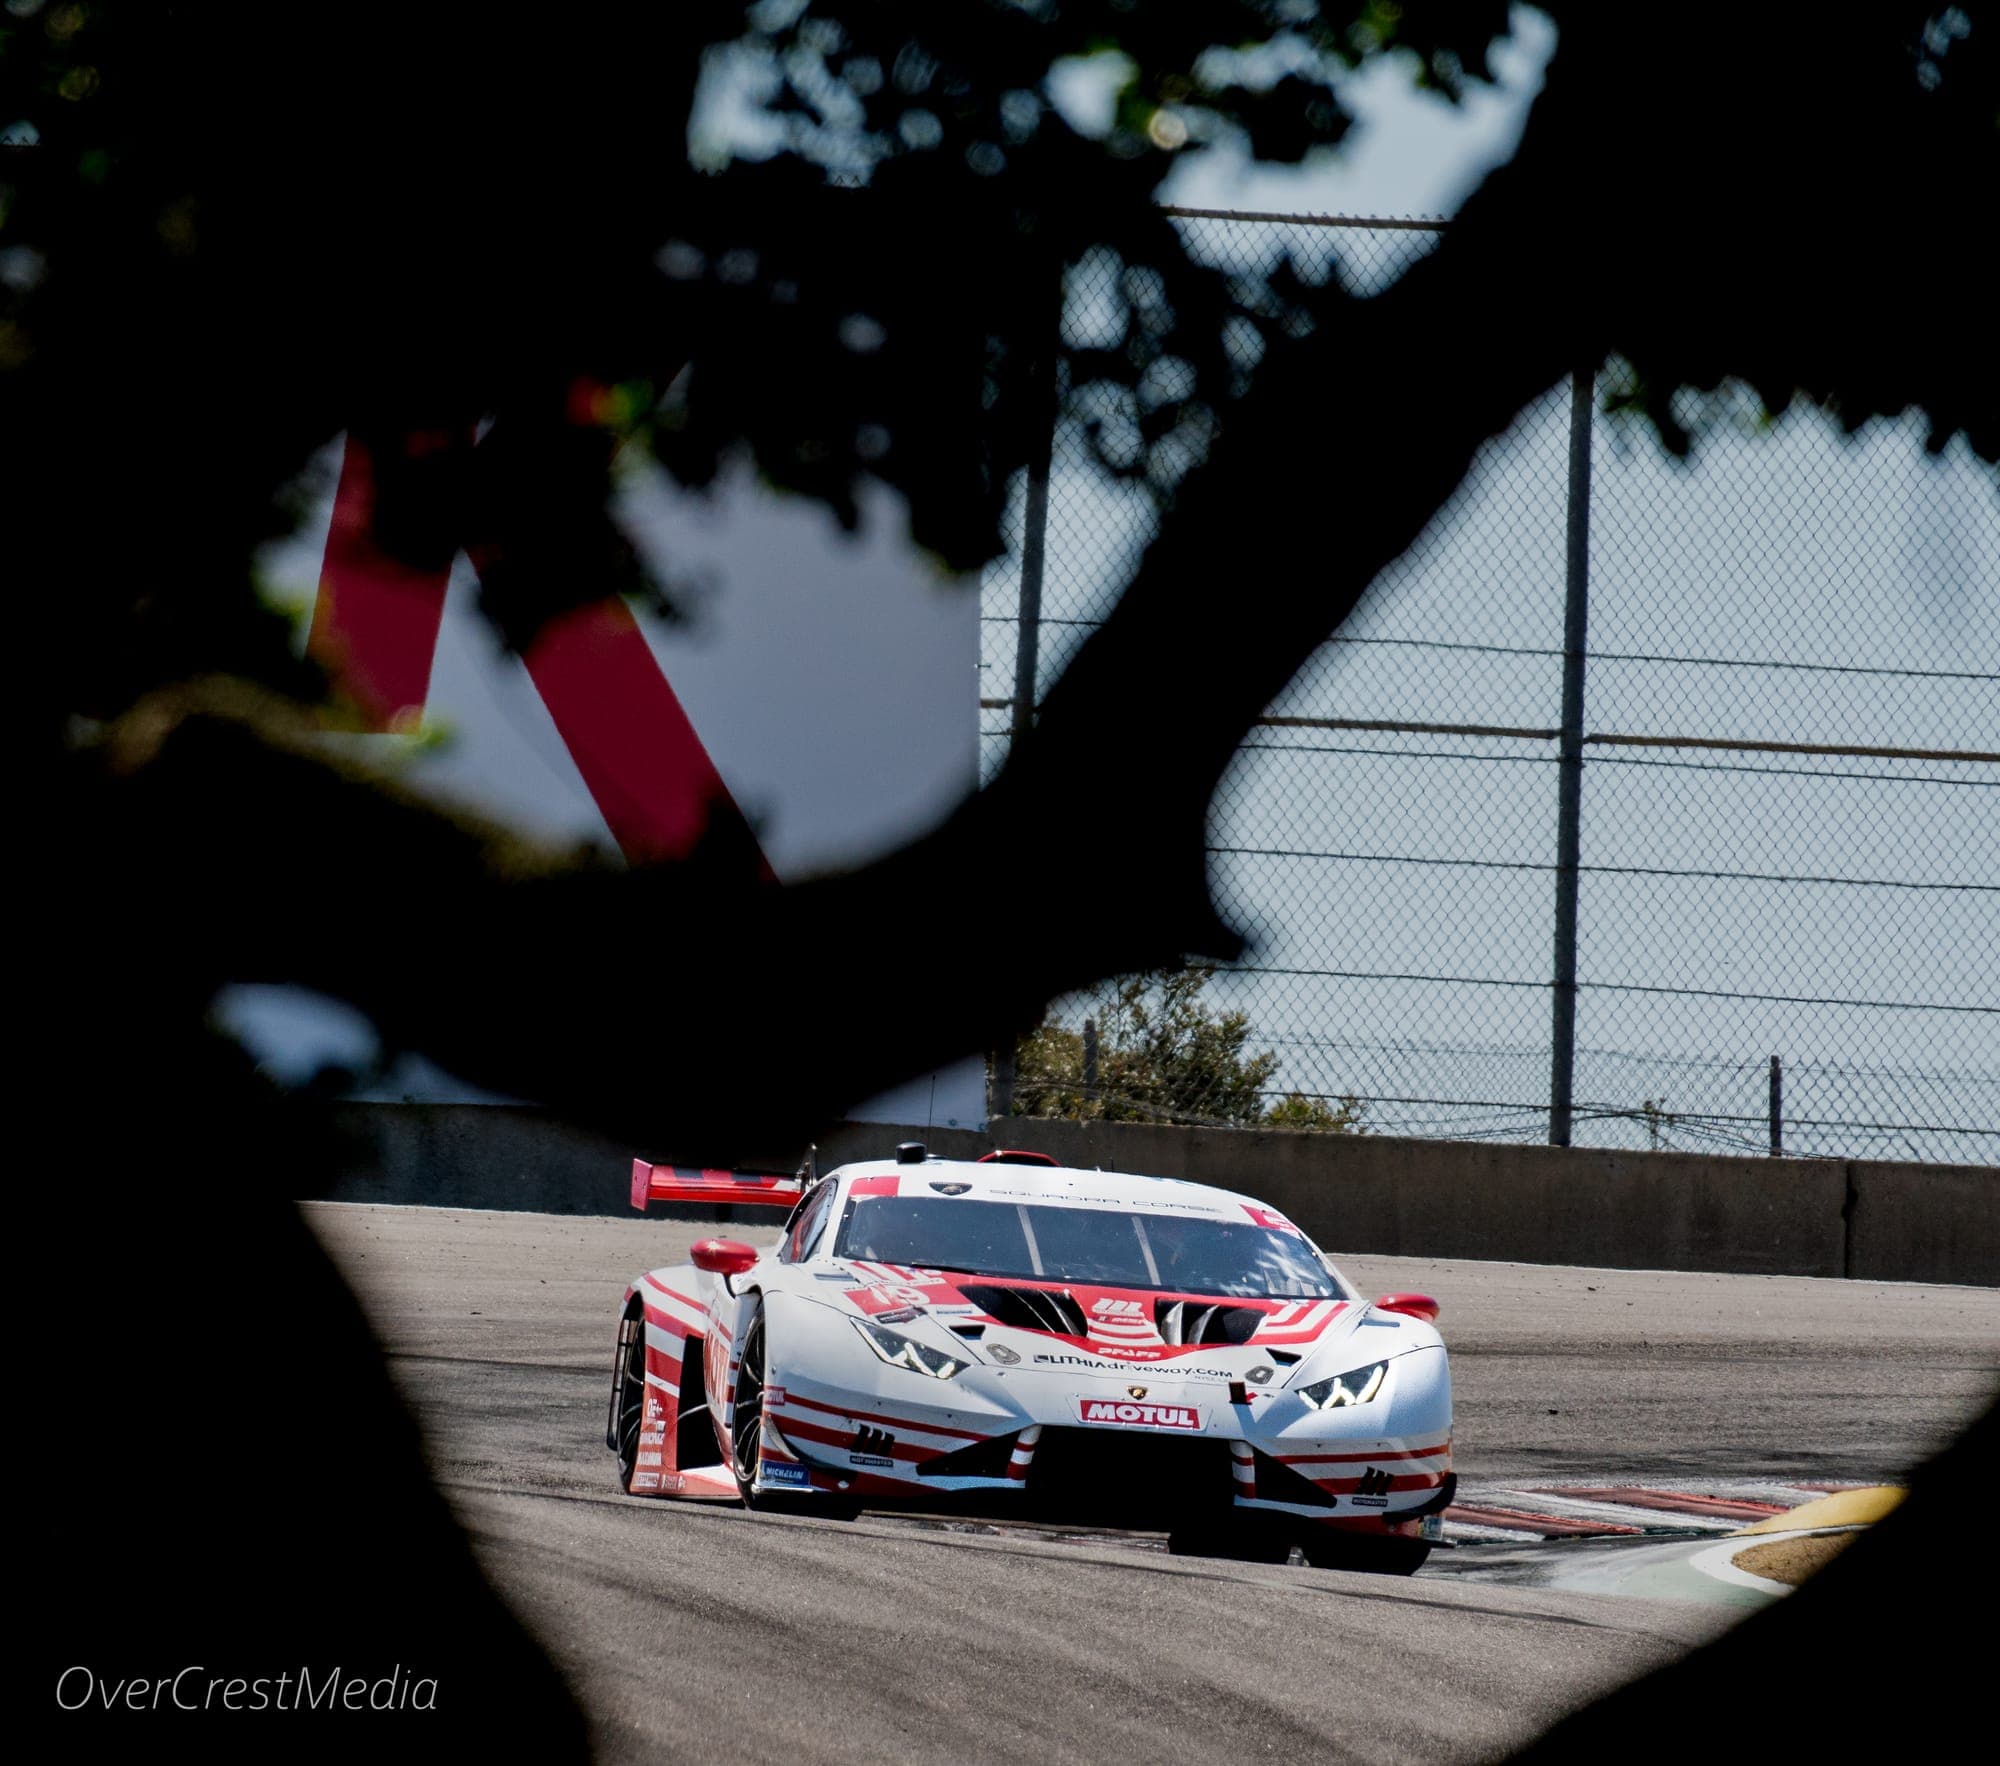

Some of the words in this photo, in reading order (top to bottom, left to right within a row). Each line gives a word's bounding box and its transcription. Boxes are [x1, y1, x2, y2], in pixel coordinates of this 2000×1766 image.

[1098, 1347, 1161, 1358] PFAFF
[1087, 1403, 1195, 1426] MOTUL
[766, 1466, 804, 1480] MICHELIN
